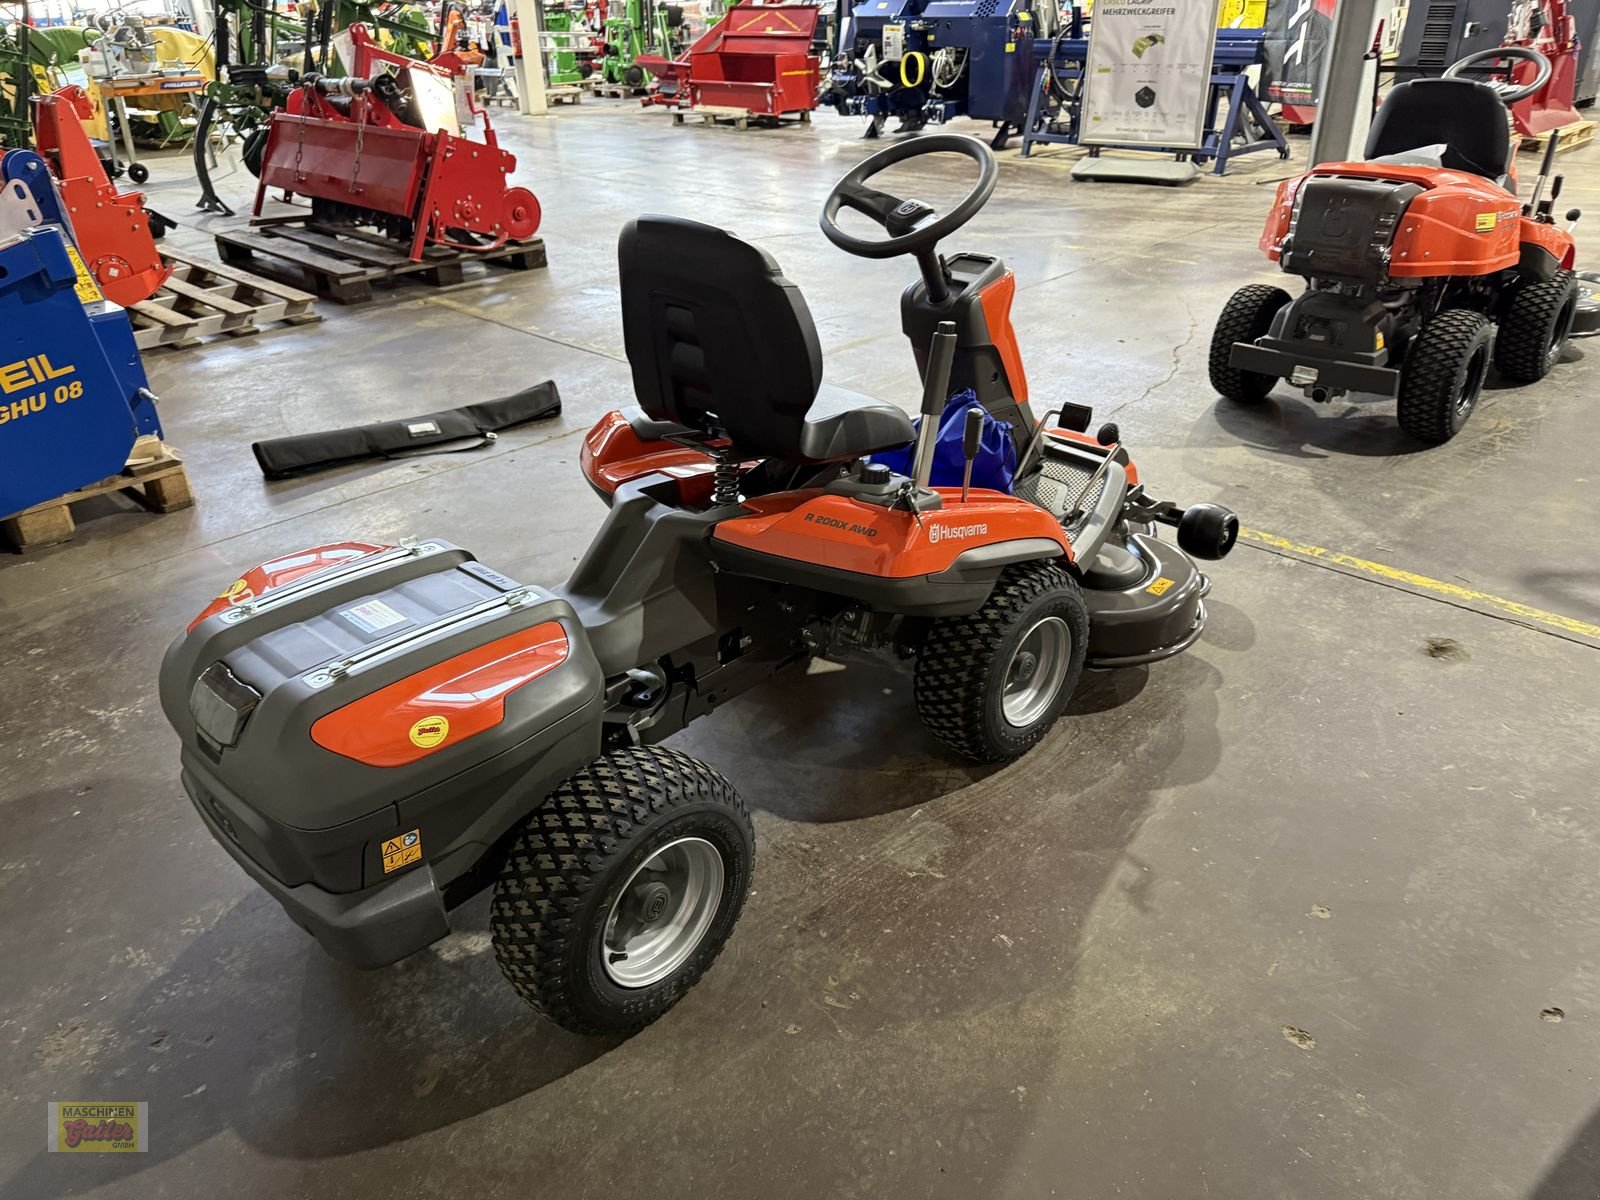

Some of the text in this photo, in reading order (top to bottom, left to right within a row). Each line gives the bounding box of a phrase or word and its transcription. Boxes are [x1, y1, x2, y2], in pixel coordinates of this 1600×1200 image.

[1102, 7, 1176, 16] MEHRZWECKGREIFER
[54, 380, 83, 404] 08
[804, 513, 878, 537] R 200iX AWD
[940, 523, 988, 540] Husqvarna
